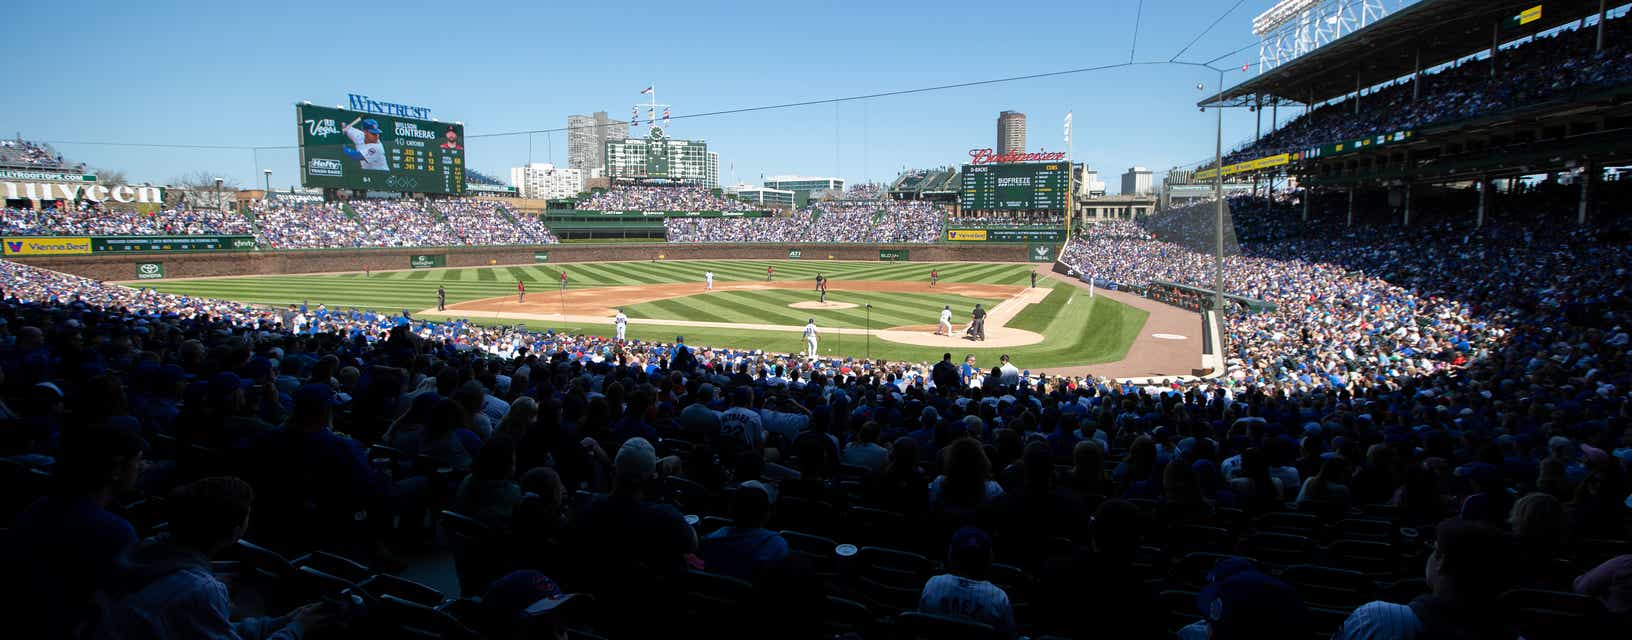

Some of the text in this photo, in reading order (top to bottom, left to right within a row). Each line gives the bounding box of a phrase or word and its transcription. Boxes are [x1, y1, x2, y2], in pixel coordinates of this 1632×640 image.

[348, 93, 431, 119] WINTRUST
[395, 127, 435, 139] CONTRERAS
[968, 148, 1066, 164] Budweiser
[313, 159, 338, 169] Hefty
[0, 170, 83, 181] LEYROOFTOPS.COM
[28, 242, 65, 251] Vienna
[66, 242, 89, 251] Beef
